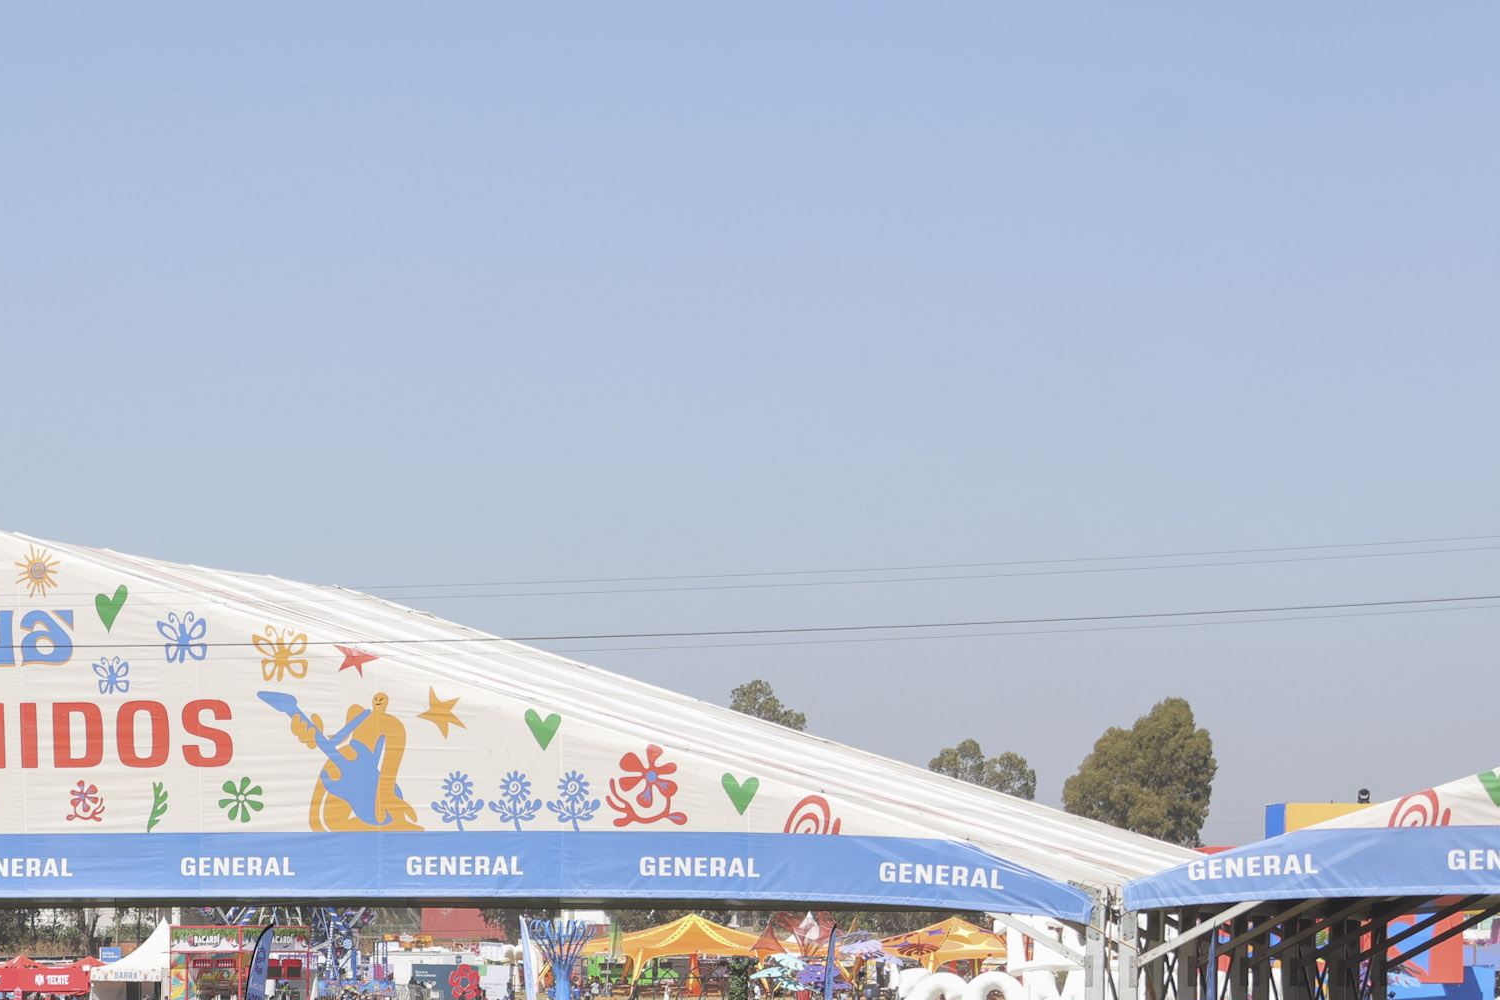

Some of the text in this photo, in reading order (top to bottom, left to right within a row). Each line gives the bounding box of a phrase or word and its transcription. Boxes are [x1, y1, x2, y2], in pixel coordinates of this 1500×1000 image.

[181, 856, 296, 876] GENERAL
[406, 856, 524, 876] GENERAL
[639, 856, 760, 878] GENERAL
[878, 862, 1004, 890] GENERAL
[1188, 853, 1319, 881] GENERAL
[194, 933, 220, 944] BACARDÍ
[272, 933, 293, 944] ACARDÍ
[45, 974, 70, 985] TECATE
[114, 971, 138, 979] BARRA
